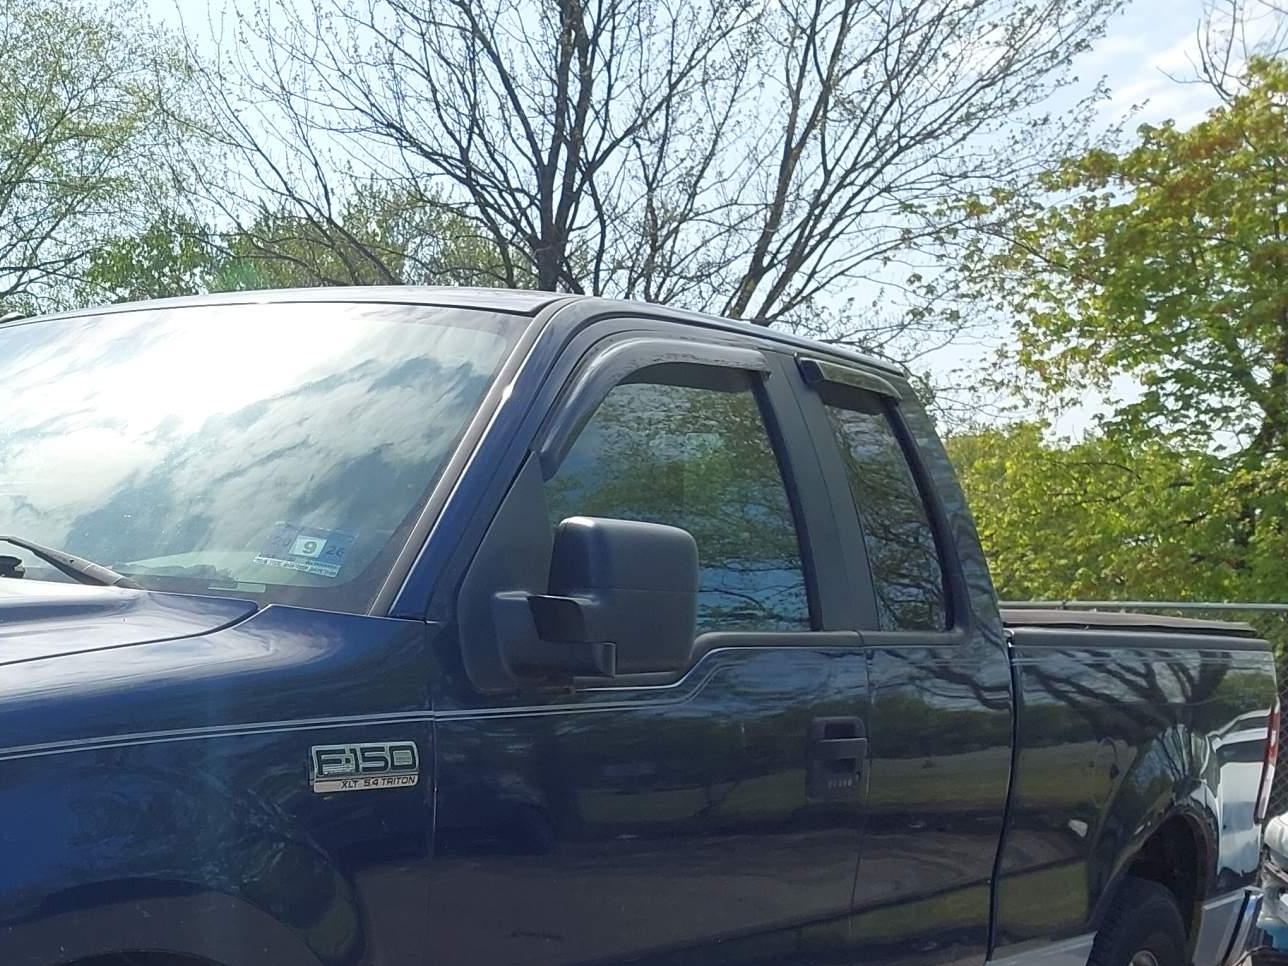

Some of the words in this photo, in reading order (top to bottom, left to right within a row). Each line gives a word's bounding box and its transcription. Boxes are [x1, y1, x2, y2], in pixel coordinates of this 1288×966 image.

[302, 541, 318, 554] 9
[315, 744, 417, 776] F-150
[341, 780, 359, 789] XLT
[381, 776, 416, 786] TRITON
